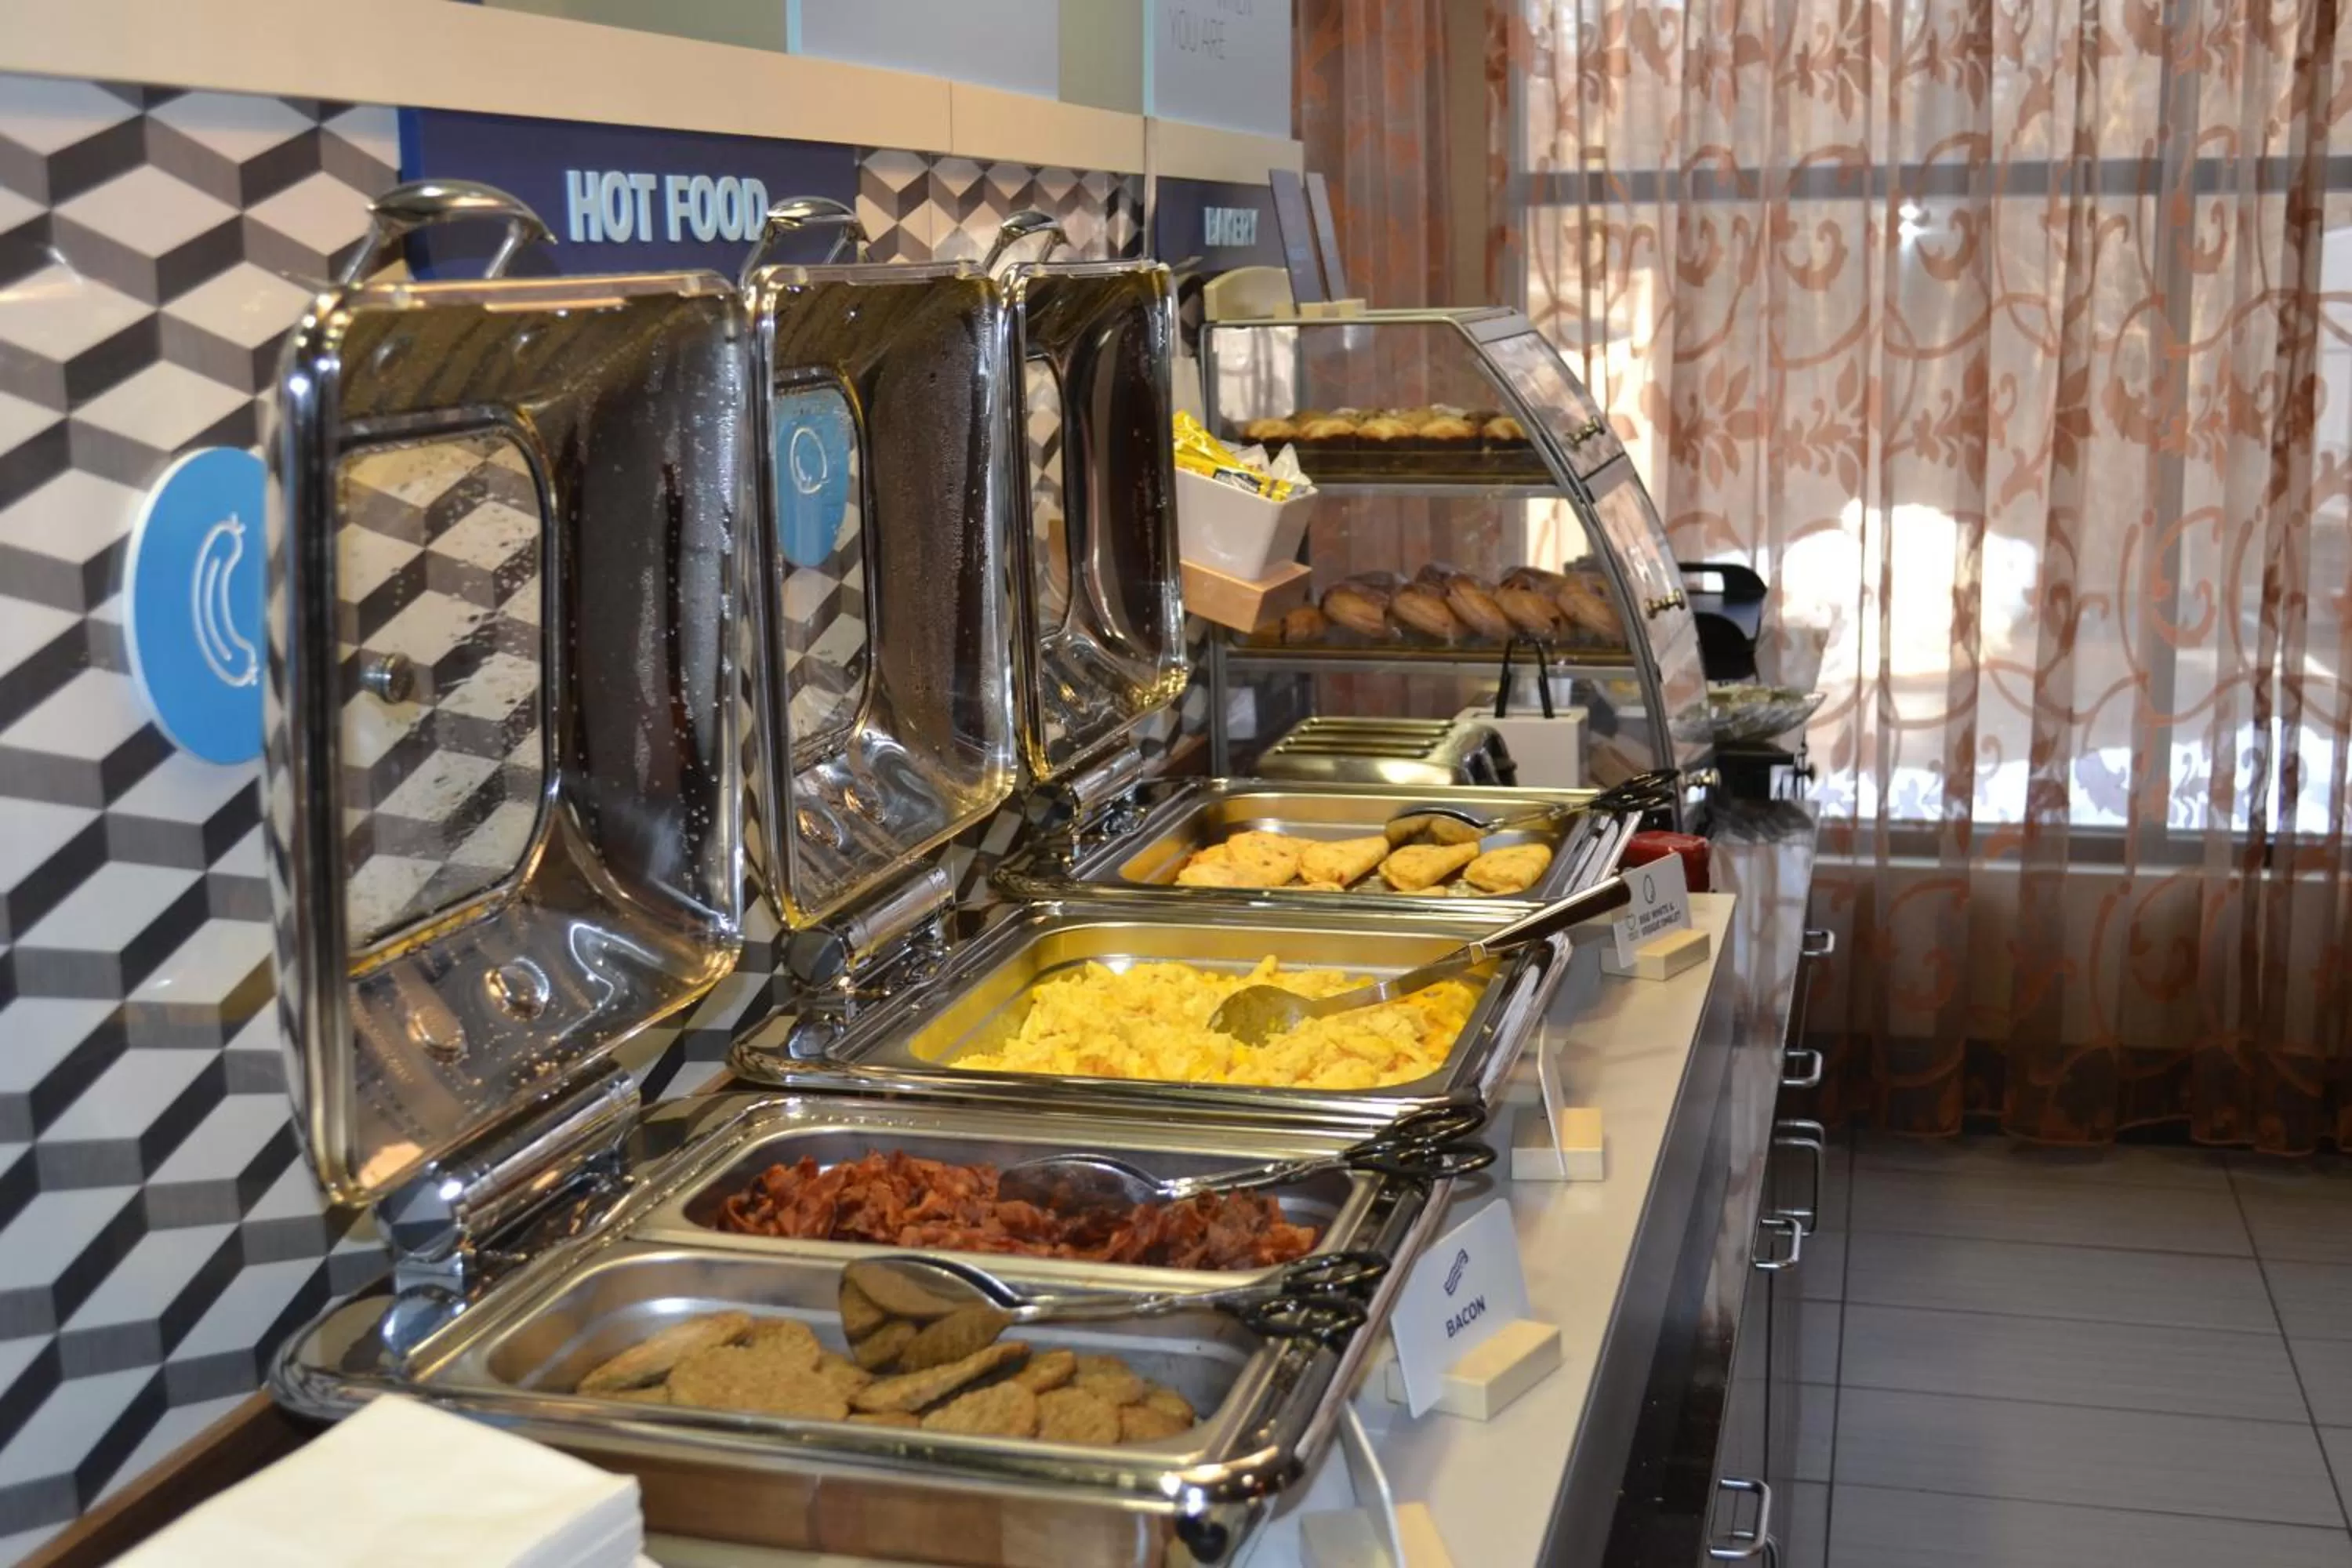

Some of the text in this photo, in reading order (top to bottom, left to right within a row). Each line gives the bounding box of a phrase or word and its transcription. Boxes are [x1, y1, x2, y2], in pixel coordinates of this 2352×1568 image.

[565, 169, 768, 243] HOT FOOD
[1204, 206, 1259, 246] BAKERY
[1445, 1295, 1486, 1338] BACON
